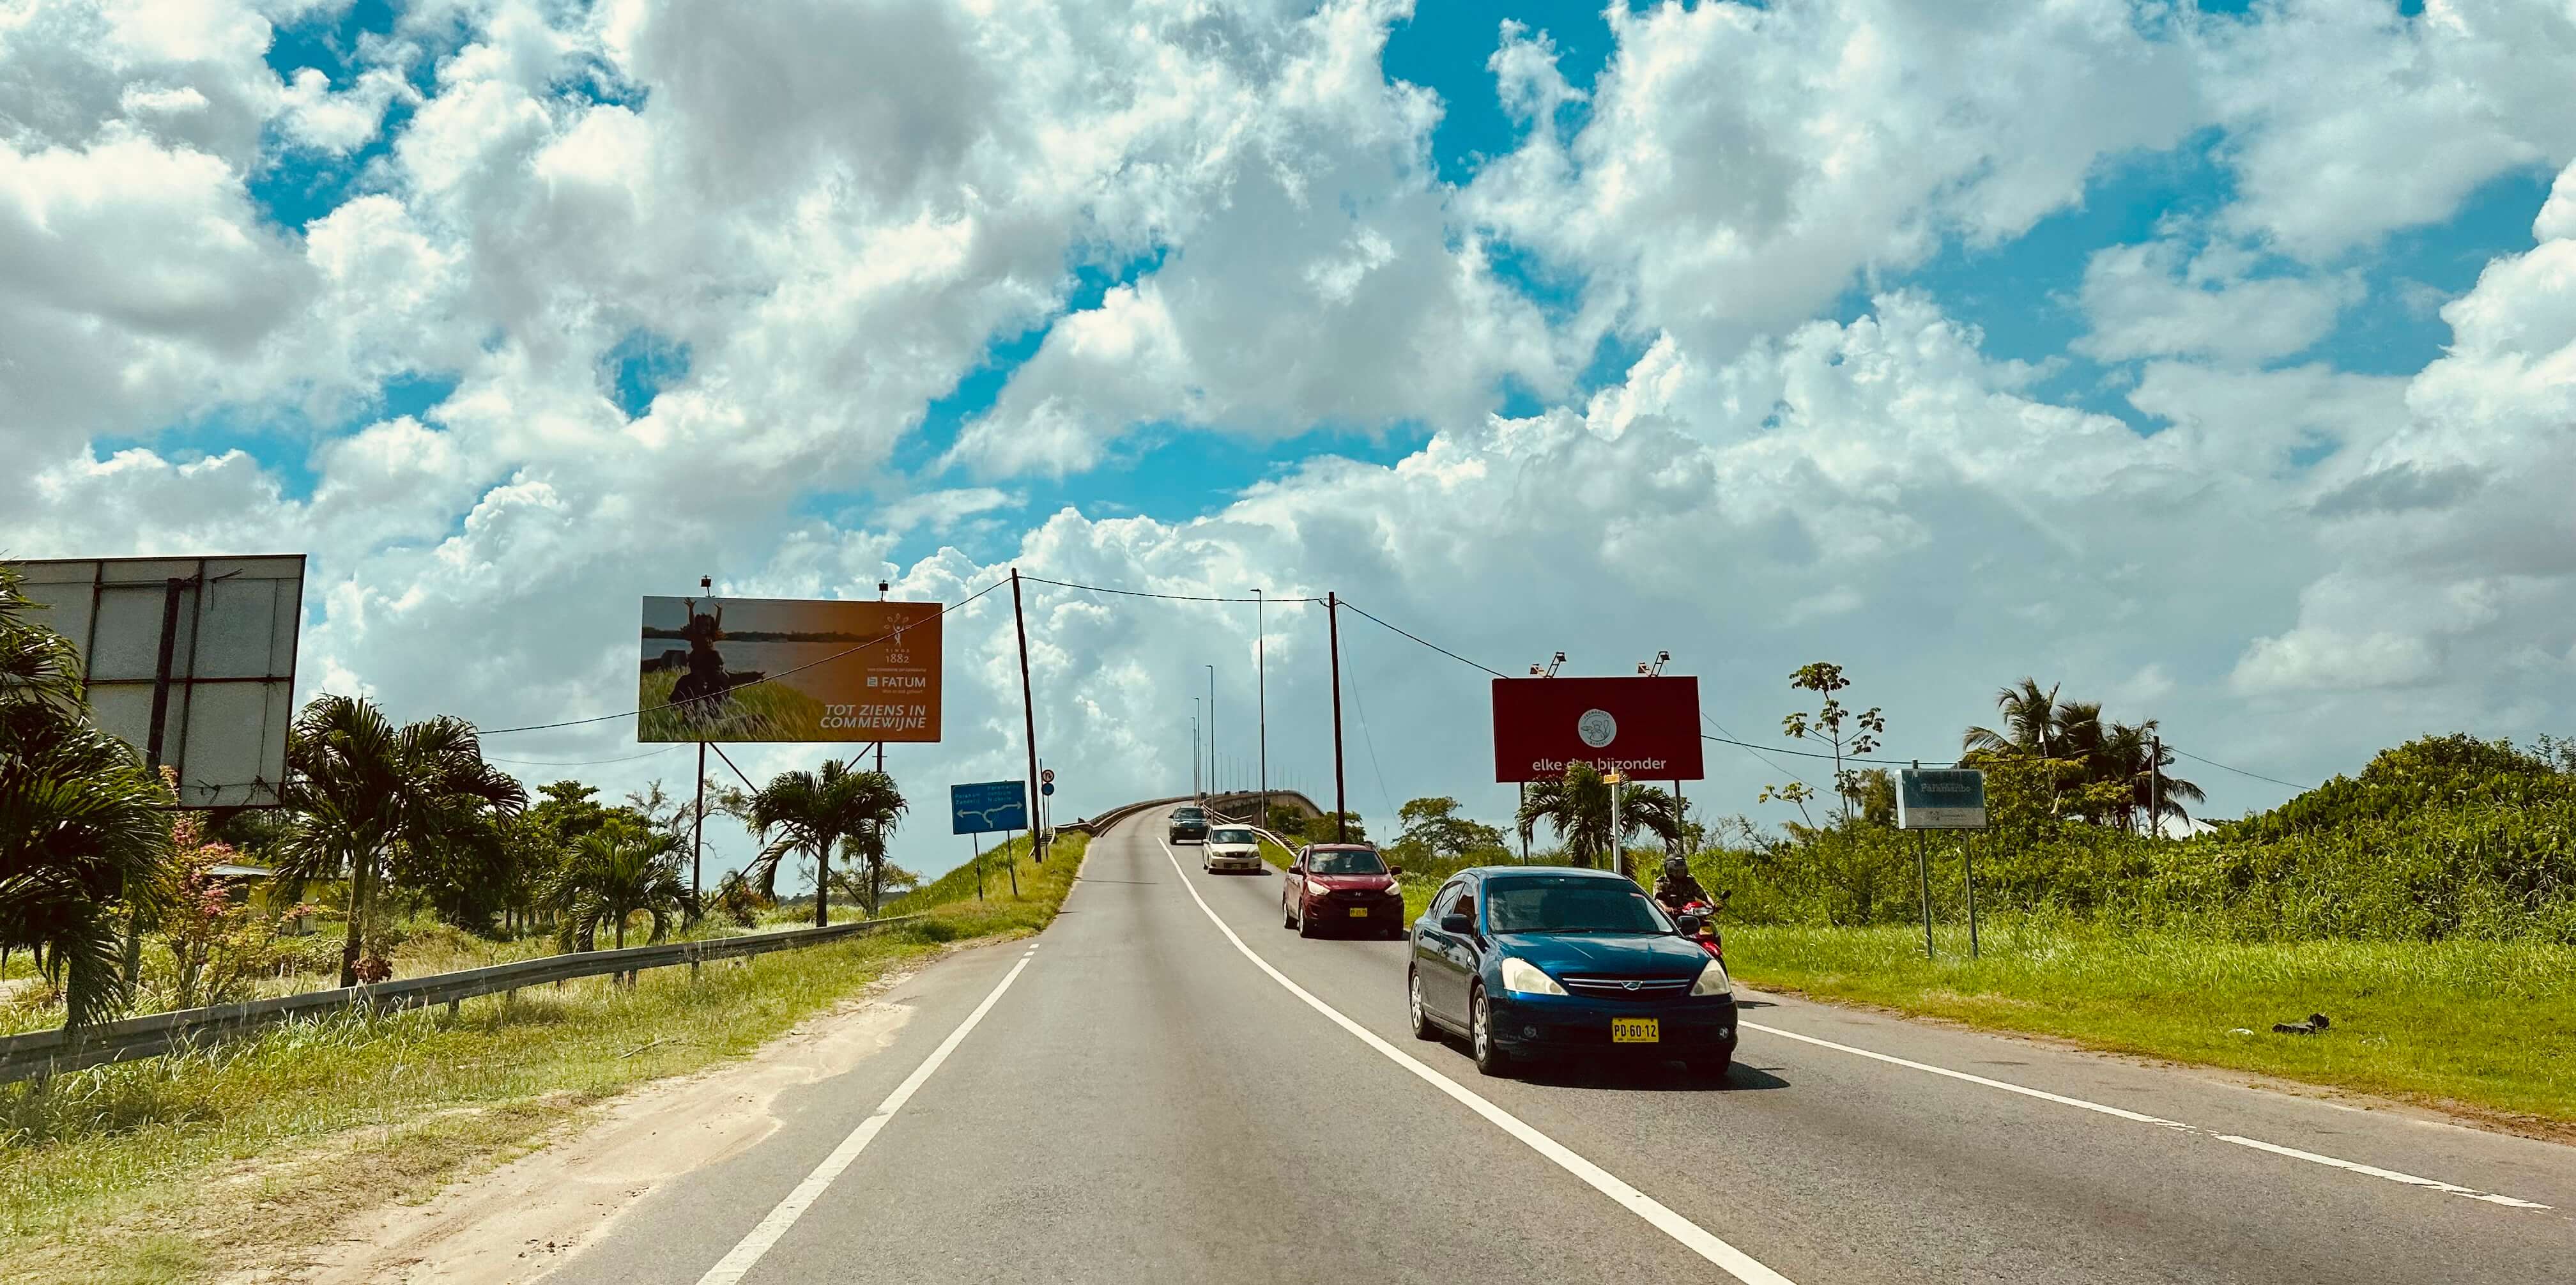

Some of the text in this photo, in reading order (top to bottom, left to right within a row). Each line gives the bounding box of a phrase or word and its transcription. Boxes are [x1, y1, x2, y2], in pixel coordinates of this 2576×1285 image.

[885, 654, 909, 664] 1882
[882, 677, 926, 688] FATUM
[825, 705, 926, 716] TOT ZIENS IN
[820, 717, 926, 732] COMMEWIJNE
[1532, 758, 1562, 771] elke
[1597, 757, 1667, 771] bijzonder
